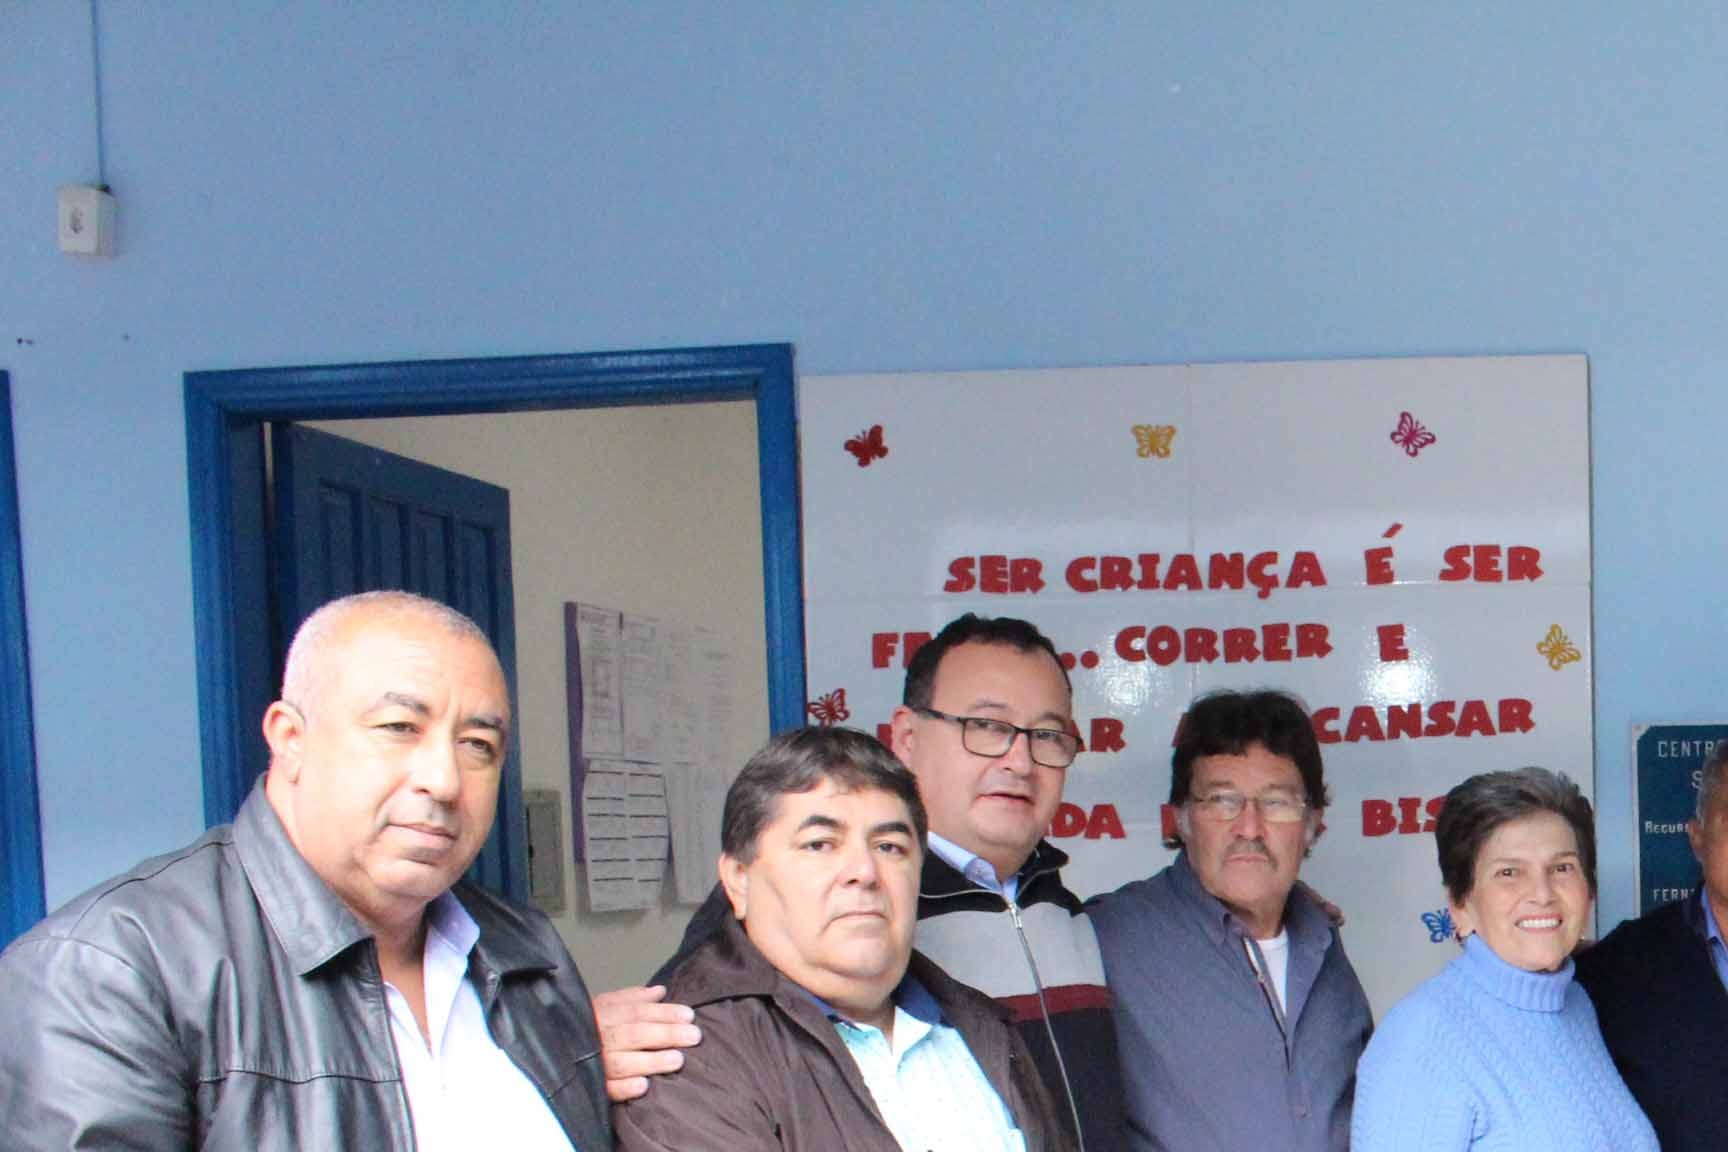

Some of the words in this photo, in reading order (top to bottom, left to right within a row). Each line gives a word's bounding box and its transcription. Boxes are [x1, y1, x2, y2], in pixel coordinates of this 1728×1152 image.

[943, 554, 1046, 594] SER
[1064, 551, 1327, 600] CRIANÇA
[1364, 523, 1404, 586] É
[1438, 545, 1545, 583] SER
[1114, 622, 1335, 667] CORRER
[1376, 623, 1410, 663] E
[1311, 698, 1536, 745] CANSAR
[1657, 739, 1716, 758] CENTR
